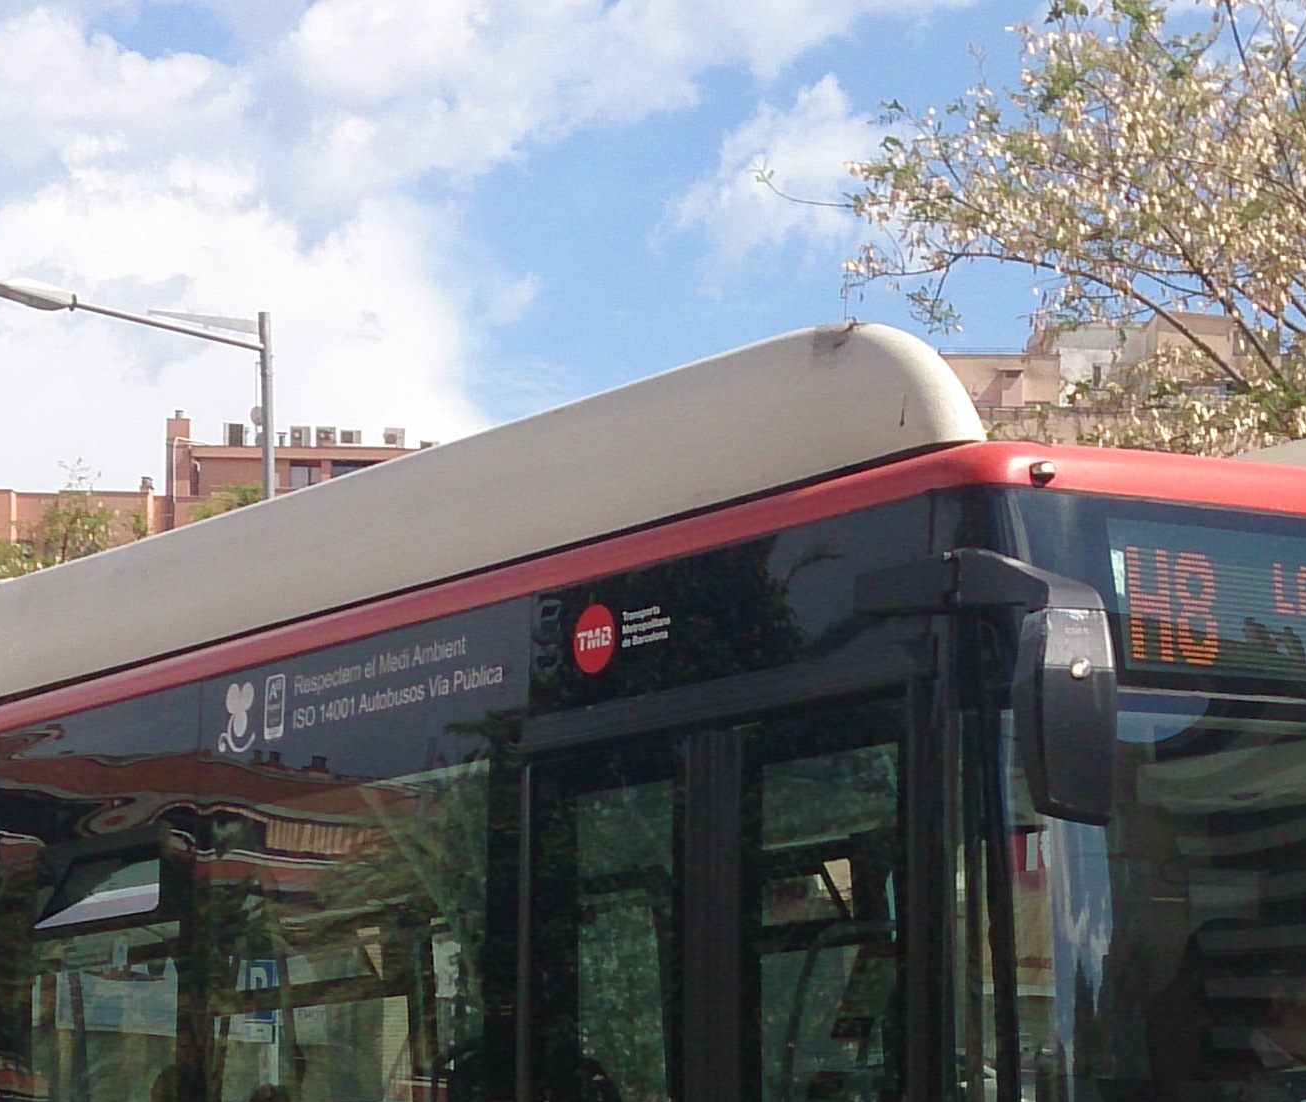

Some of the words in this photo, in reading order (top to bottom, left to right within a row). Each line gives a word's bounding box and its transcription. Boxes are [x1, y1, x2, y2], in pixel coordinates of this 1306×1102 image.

[1125, 545, 1219, 666] H8
[294, 668, 361, 697] Respectem
[364, 660, 376, 679] el
[379, 650, 410, 674] Medi
[413, 636, 467, 665] Ambient
[577, 625, 612, 651] TMB
[293, 708, 315, 730] ISO
[320, 695, 356, 723] 14001
[358, 683, 425, 715] Autobusos
[453, 663, 504, 694] Pública
